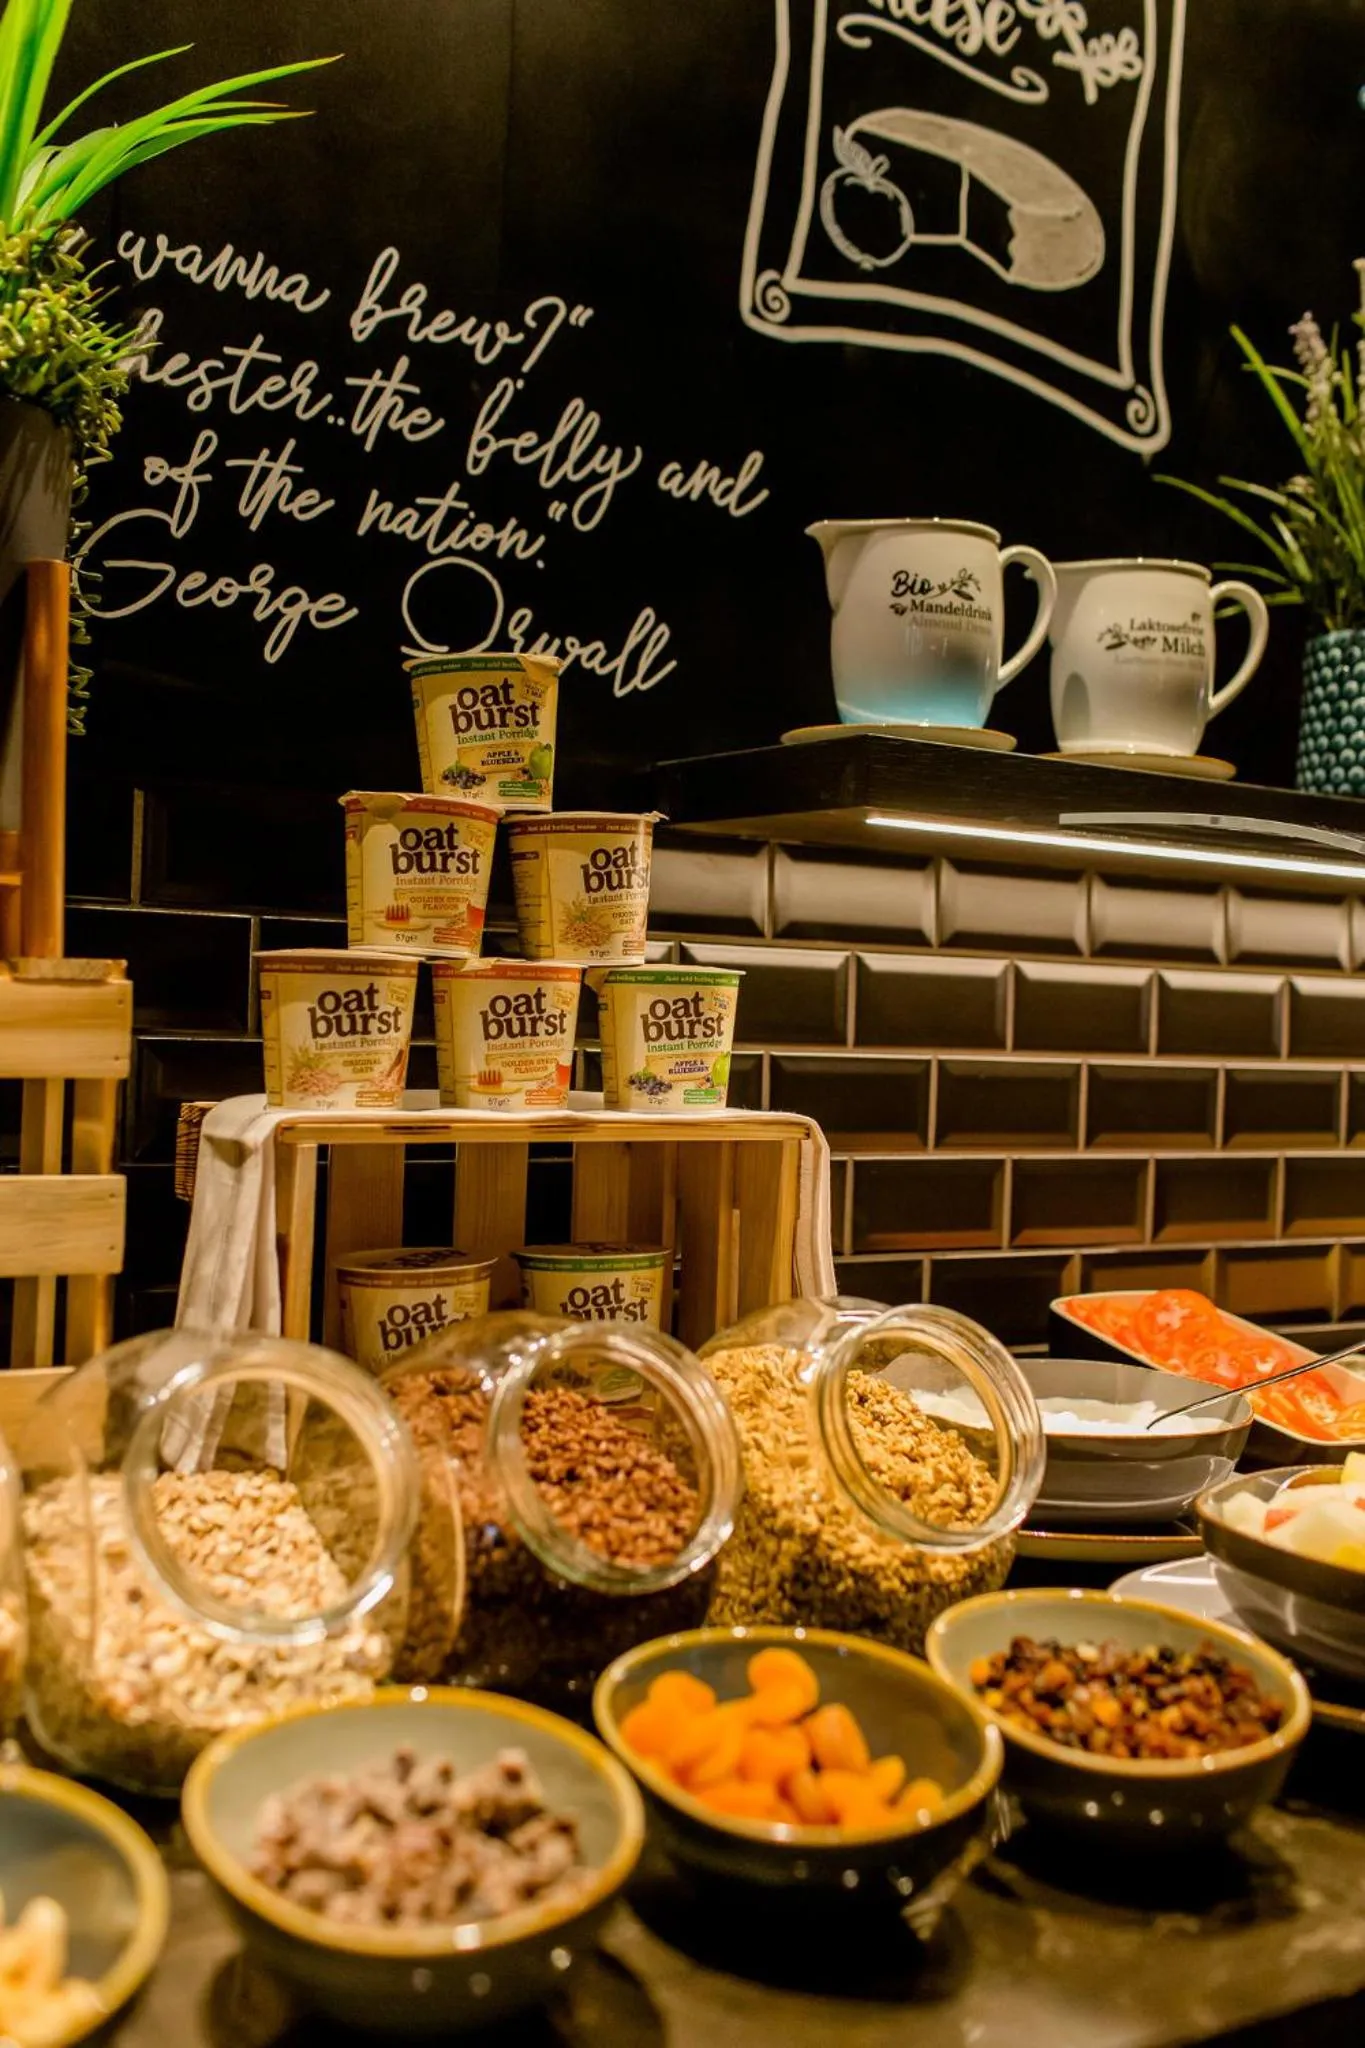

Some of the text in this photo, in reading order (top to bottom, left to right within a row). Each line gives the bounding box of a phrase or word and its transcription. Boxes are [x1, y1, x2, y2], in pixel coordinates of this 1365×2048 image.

[117, 229, 331, 313] wanna
[466, 376, 642, 531] belly
[657, 451, 769, 517] and
[144, 429, 217, 538] of
[226, 438, 335, 531] the
[71, 508, 359, 663] George
[890, 570, 933, 598] Bio
[1161, 634, 1206, 658] Milch
[457, 677, 516, 710] oat
[449, 701, 540, 734] burst
[457, 732, 497, 745] Instant
[400, 822, 459, 850] oat
[389, 843, 480, 875] burst
[590, 841, 638, 870] oat
[395, 876, 436, 886] Instant
[318, 982, 379, 1014] oat
[489, 986, 547, 1017] oat
[649, 991, 705, 1020] oat
[307, 1006, 402, 1039] burst
[479, 1009, 568, 1041] burst
[640, 1013, 726, 1043] burst
[315, 1038, 357, 1051] Instant
[487, 1039, 526, 1051] Instant
[647, 1041, 685, 1053] Instant
[567, 1277, 626, 1310] oat
[386, 1293, 449, 1328] oat
[378, 1313, 470, 1352] bur
